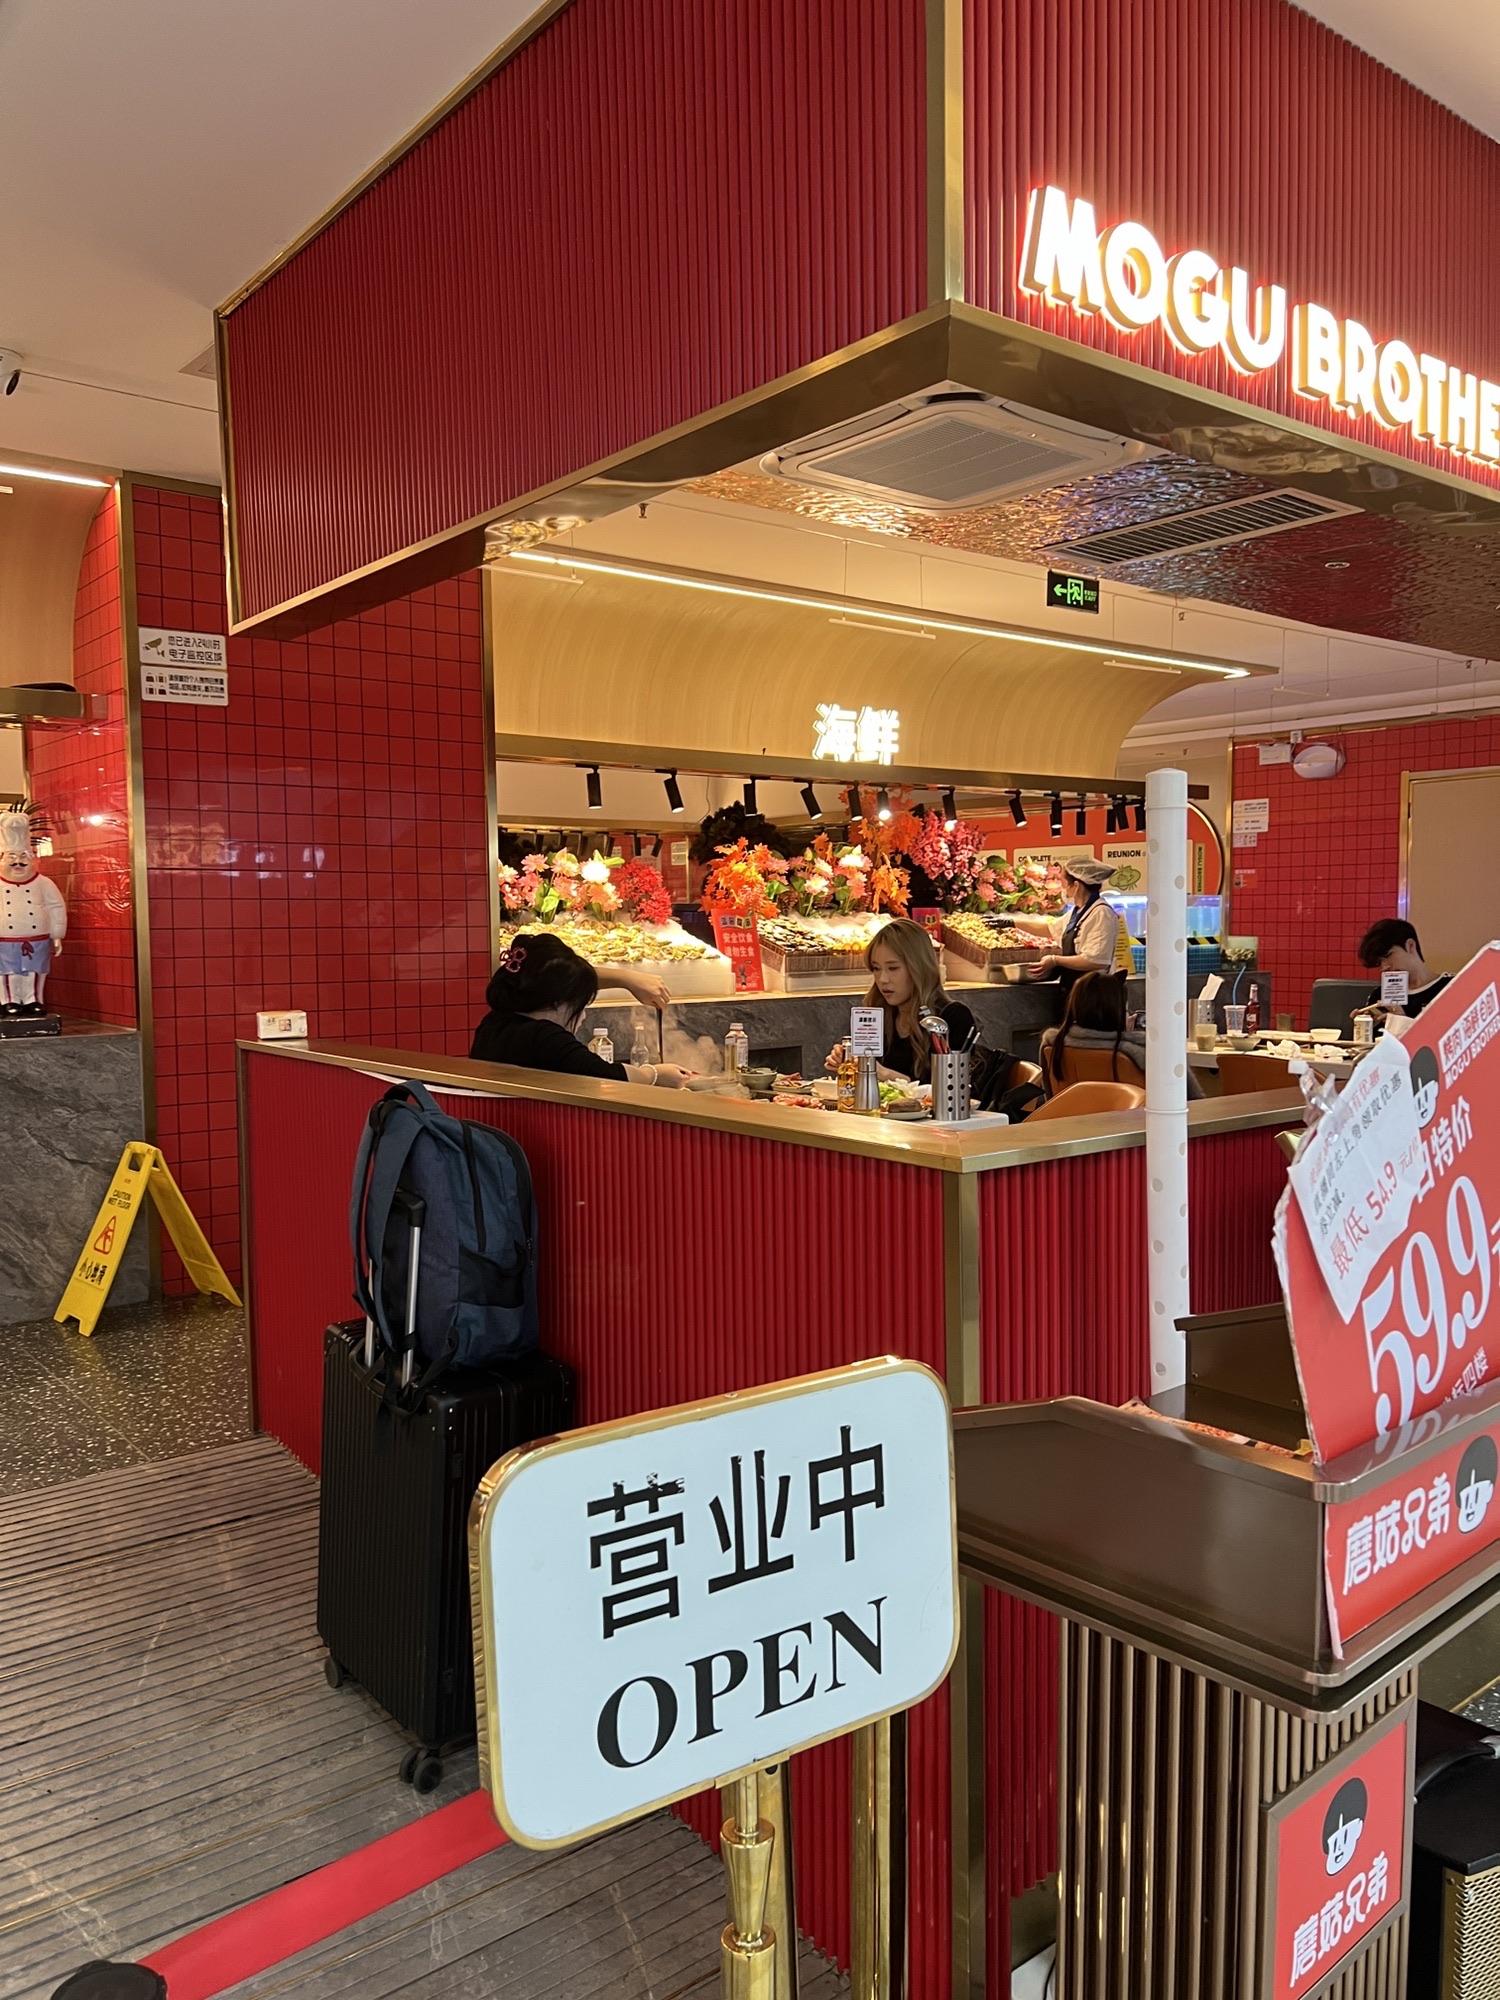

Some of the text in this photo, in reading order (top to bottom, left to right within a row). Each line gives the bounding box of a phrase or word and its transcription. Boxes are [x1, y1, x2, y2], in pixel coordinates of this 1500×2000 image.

[1018, 185, 1286, 374] MOGU
[169, 649, 222, 661] 电子监控区域
[812, 703, 900, 766] 海鲜
[1107, 850, 1141, 858] REUNION
[722, 932, 753, 943] 安全饮食
[1445, 1051, 1471, 1090] MOGU
[1330, 1206, 1370, 1281] 最低
[1366, 1161, 1397, 1221] 54.9
[1362, 1176, 1491, 1438] 59.9
[587, 1425, 885, 1640] 营业中
[1343, 1472, 1451, 1596] 蘑菇兄弟
[596, 1596, 887, 1769] OPEN
[1290, 1851, 1388, 1988] 蘑菇兄弟
